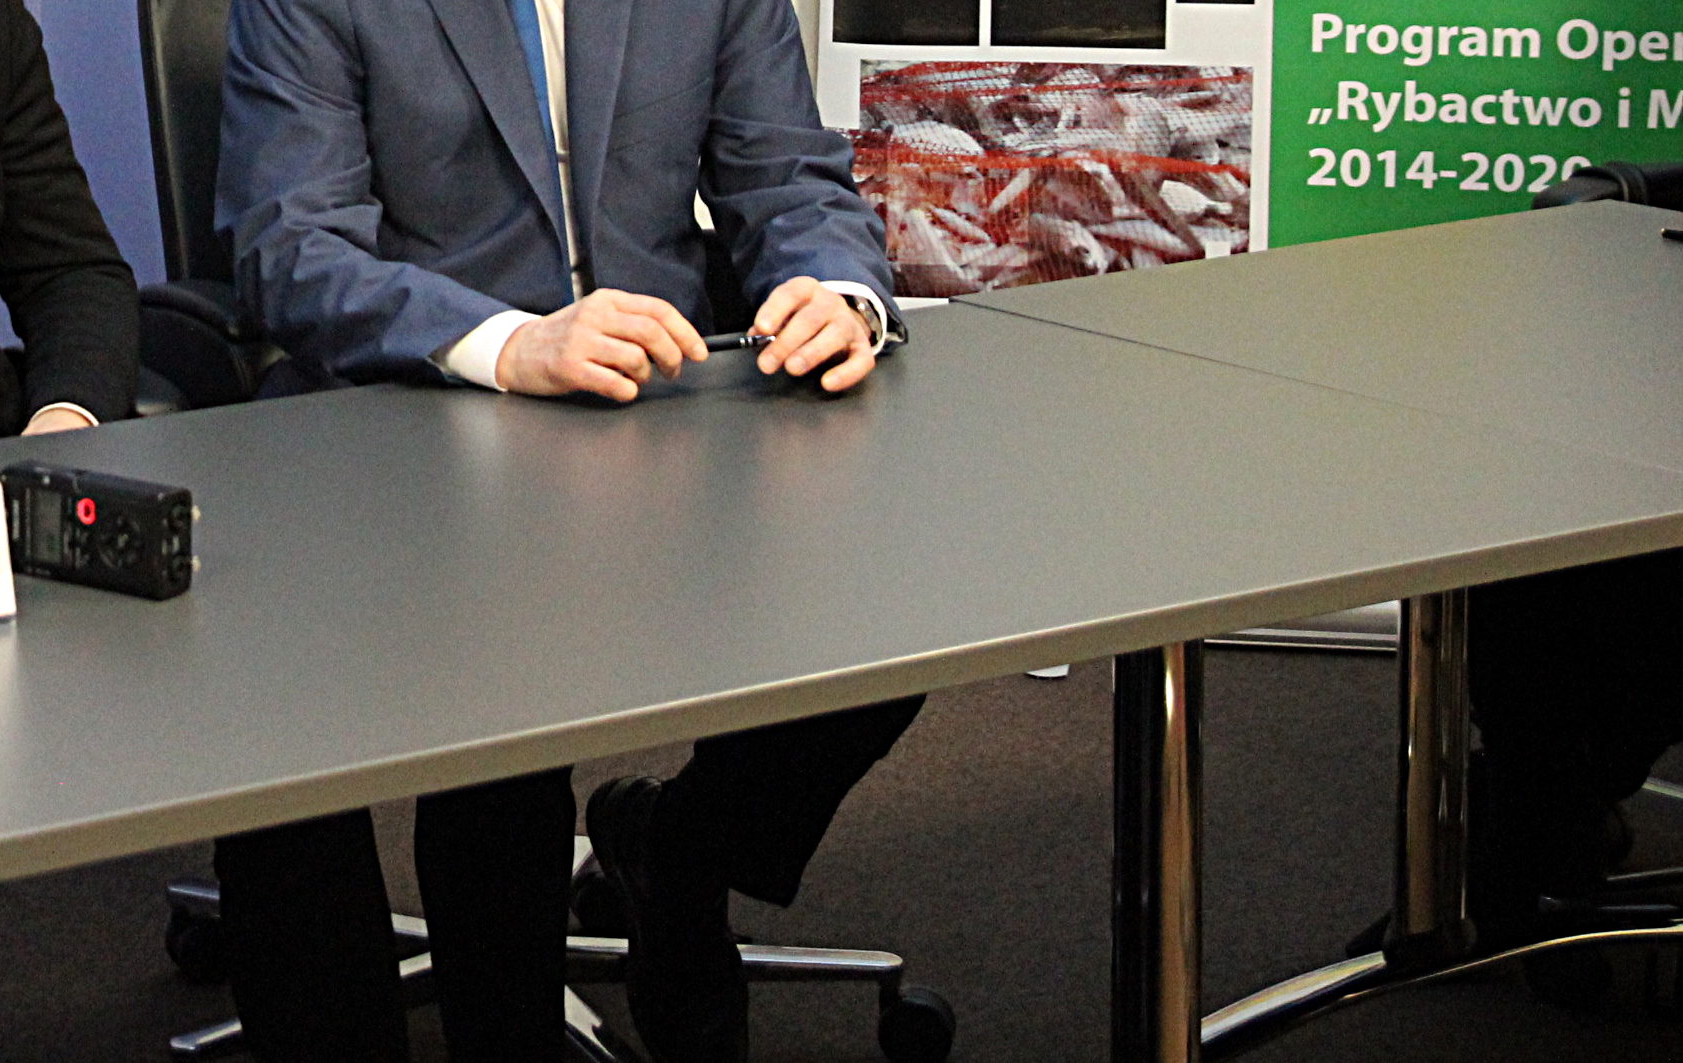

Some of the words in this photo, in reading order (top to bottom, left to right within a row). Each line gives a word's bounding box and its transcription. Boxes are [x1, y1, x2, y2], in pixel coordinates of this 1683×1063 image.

[1311, 12, 1542, 67] Program
[1306, 79, 1603, 133] „Rybactwo
[1617, 87, 1631, 129] i
